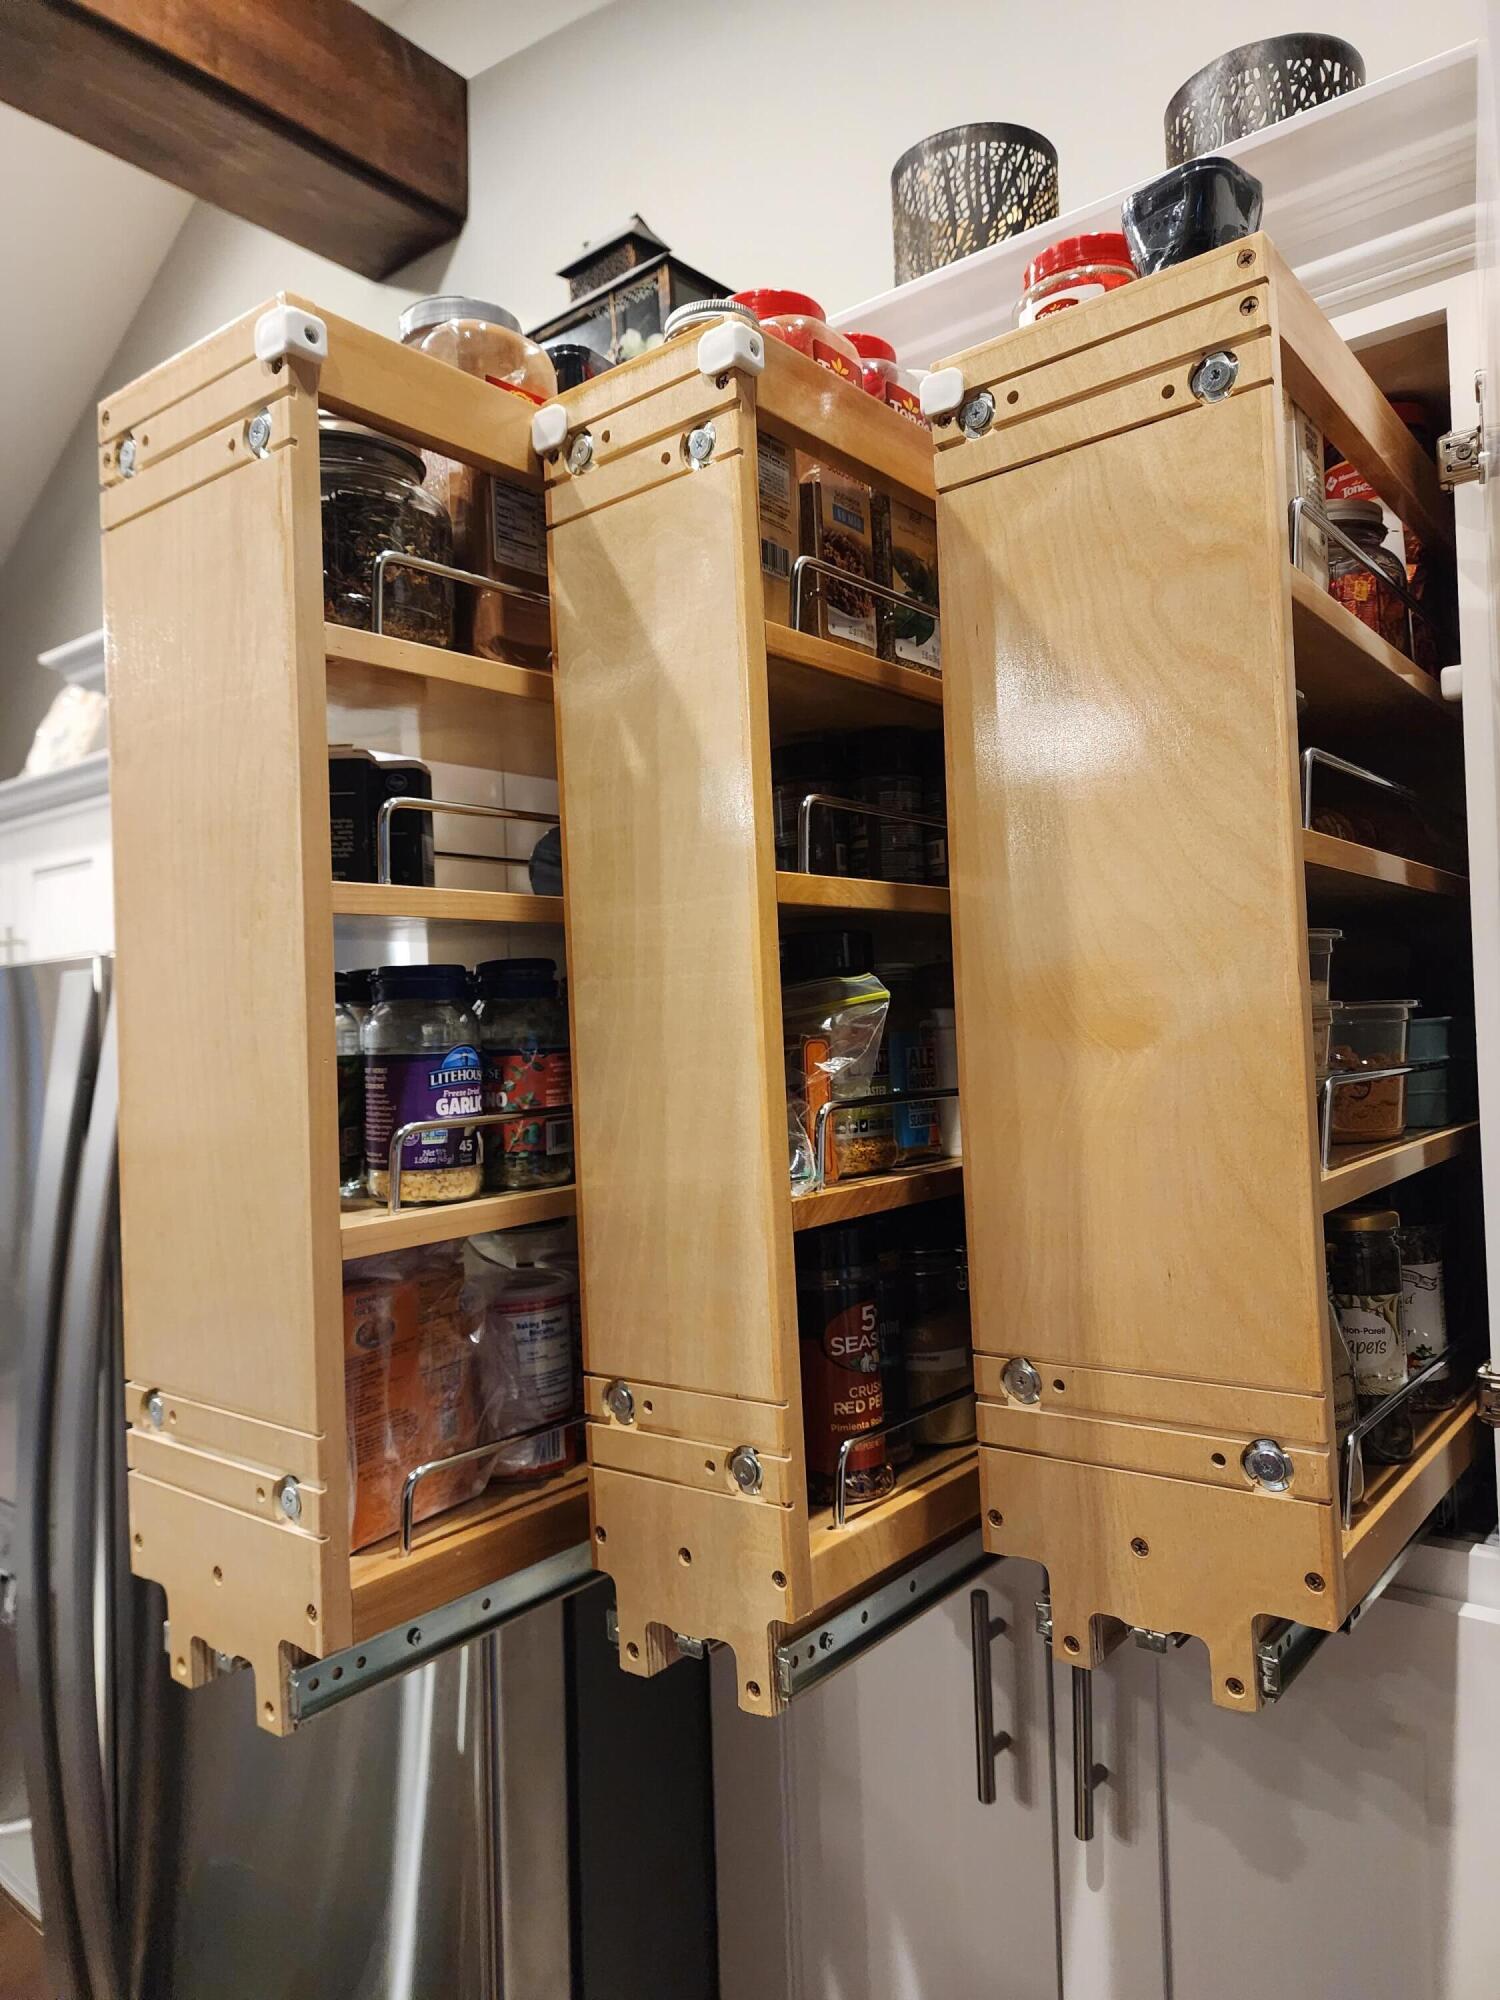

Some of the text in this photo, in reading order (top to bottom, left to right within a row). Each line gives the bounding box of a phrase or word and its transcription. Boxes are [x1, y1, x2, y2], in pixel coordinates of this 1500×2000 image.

[458, 1139, 473, 1152] 45
[861, 1303, 876, 1331] 5
[833, 1399, 866, 1416] RED
[830, 1420, 870, 1432] Pimienta
